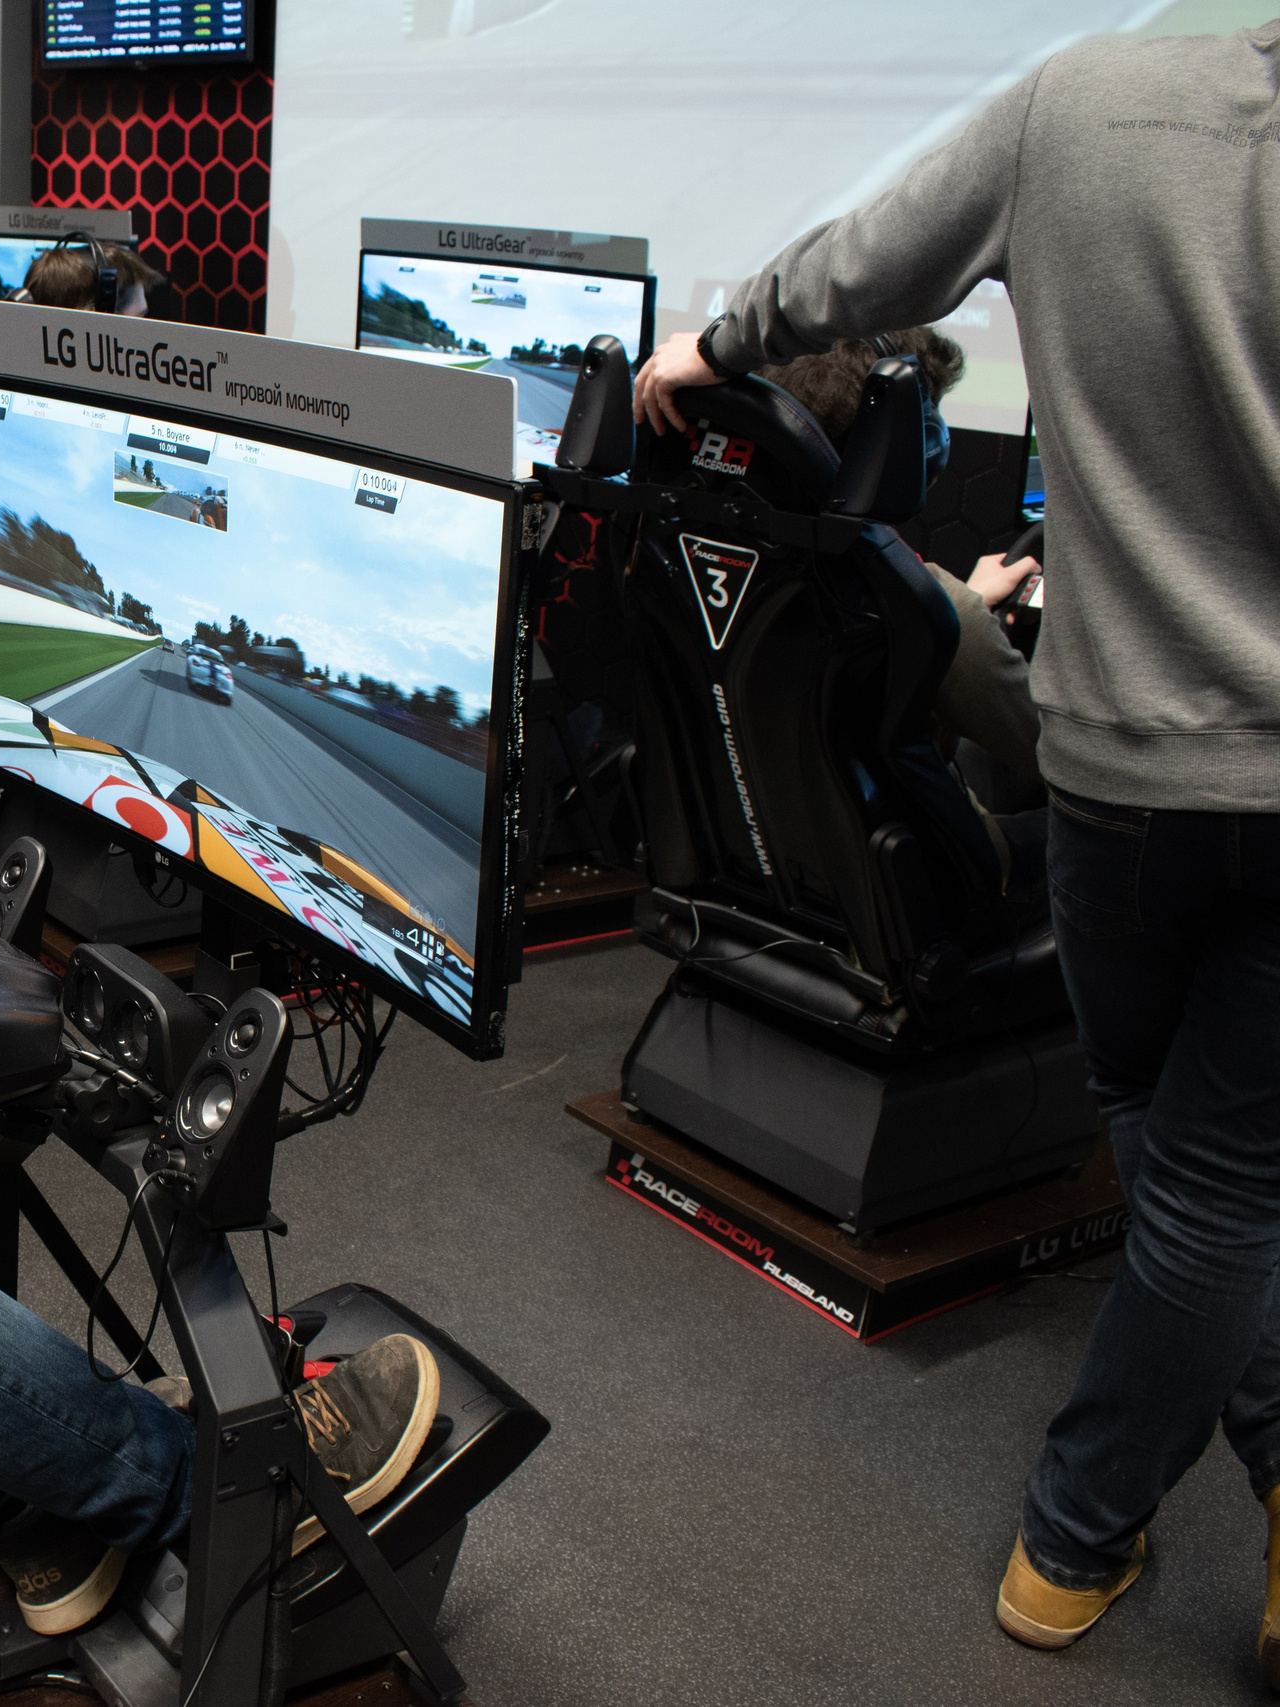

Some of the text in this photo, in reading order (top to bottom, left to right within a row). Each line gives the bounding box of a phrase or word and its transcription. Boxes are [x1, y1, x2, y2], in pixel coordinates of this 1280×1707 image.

[1108, 120, 1136, 130] WHEN
[1138, 120, 1166, 131] CARS
[1169, 121, 1199, 134] WERE
[439, 229, 457, 248] LG
[41, 325, 77, 368] LG
[225, 380, 351, 427] игровой монитор
[151, 424, 156, 435] 5
[166, 427, 190, 442] Boyare
[692, 454, 747, 476] RACEROOM
[694, 549, 751, 569] RACEROOM
[706, 567, 729, 608] 3
[712, 683, 773, 876] www.raceroom.club
[406, 927, 420, 947] 4
[633, 1169, 775, 1263] RACEROOM
[762, 1261, 855, 1324] RUSSLAND
[18, 1567, 61, 1594] das
